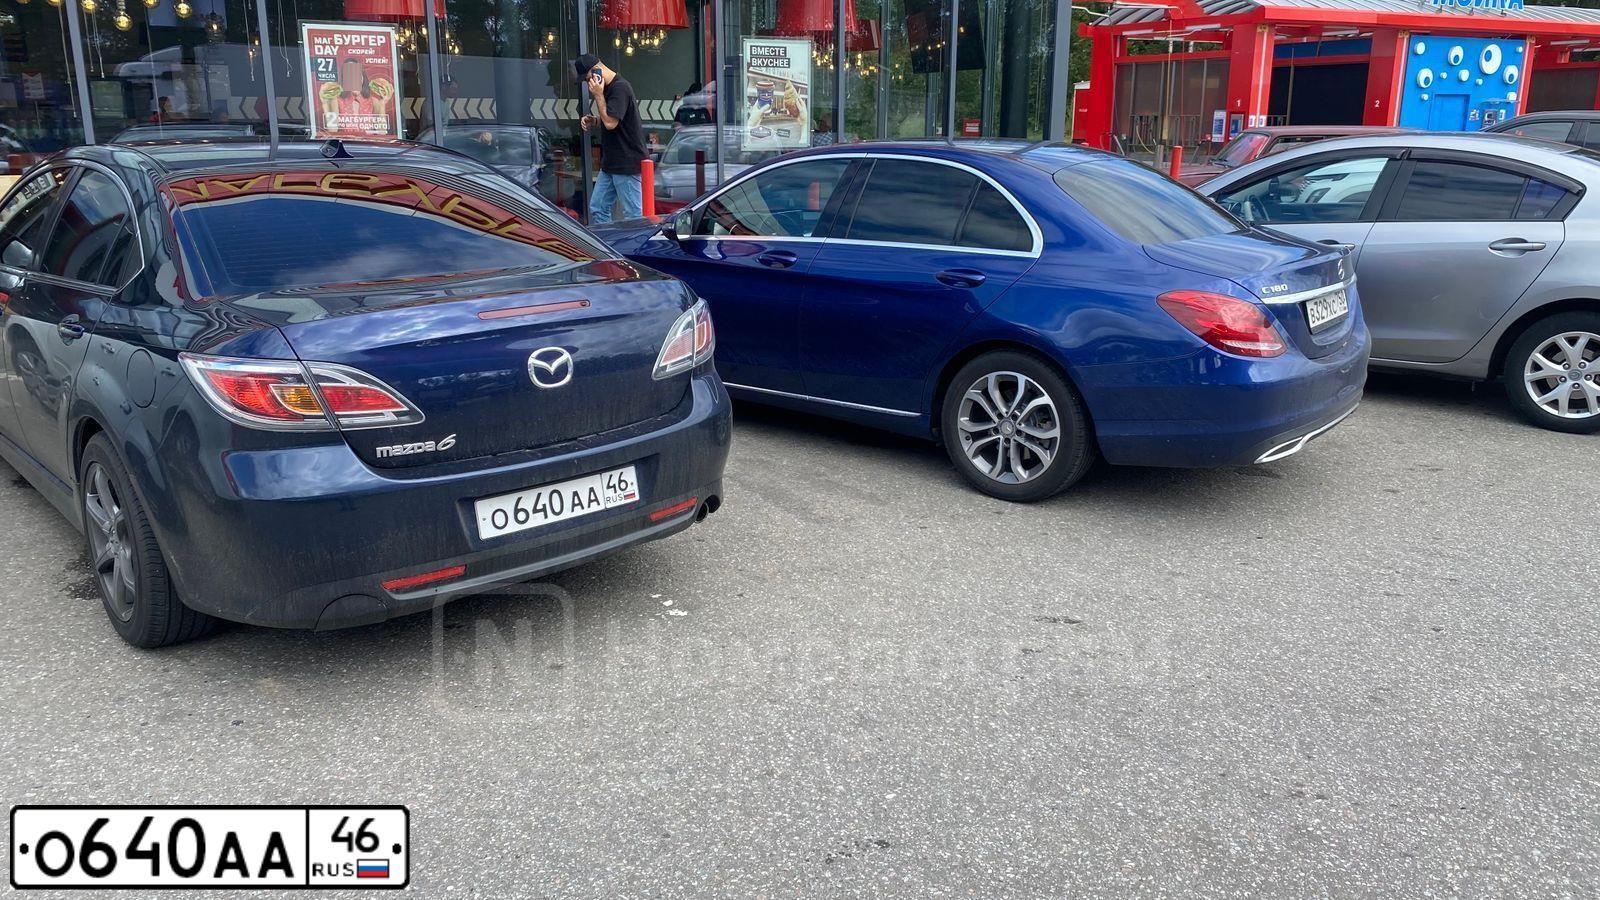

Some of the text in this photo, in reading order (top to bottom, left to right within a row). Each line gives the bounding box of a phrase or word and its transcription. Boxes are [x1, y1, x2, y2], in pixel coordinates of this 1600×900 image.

[314, 45, 340, 56] DAY
[751, 46, 786, 56] ВМЕСТЕ
[317, 58, 334, 72] 27
[751, 58, 790, 67] ВКУСНЕЕ
[1236, 99, 1241, 107] 1
[1374, 100, 1380, 108] 2
[326, 112, 338, 128] 2
[605, 471, 629, 493] 46
[605, 493, 624, 505] RUS
